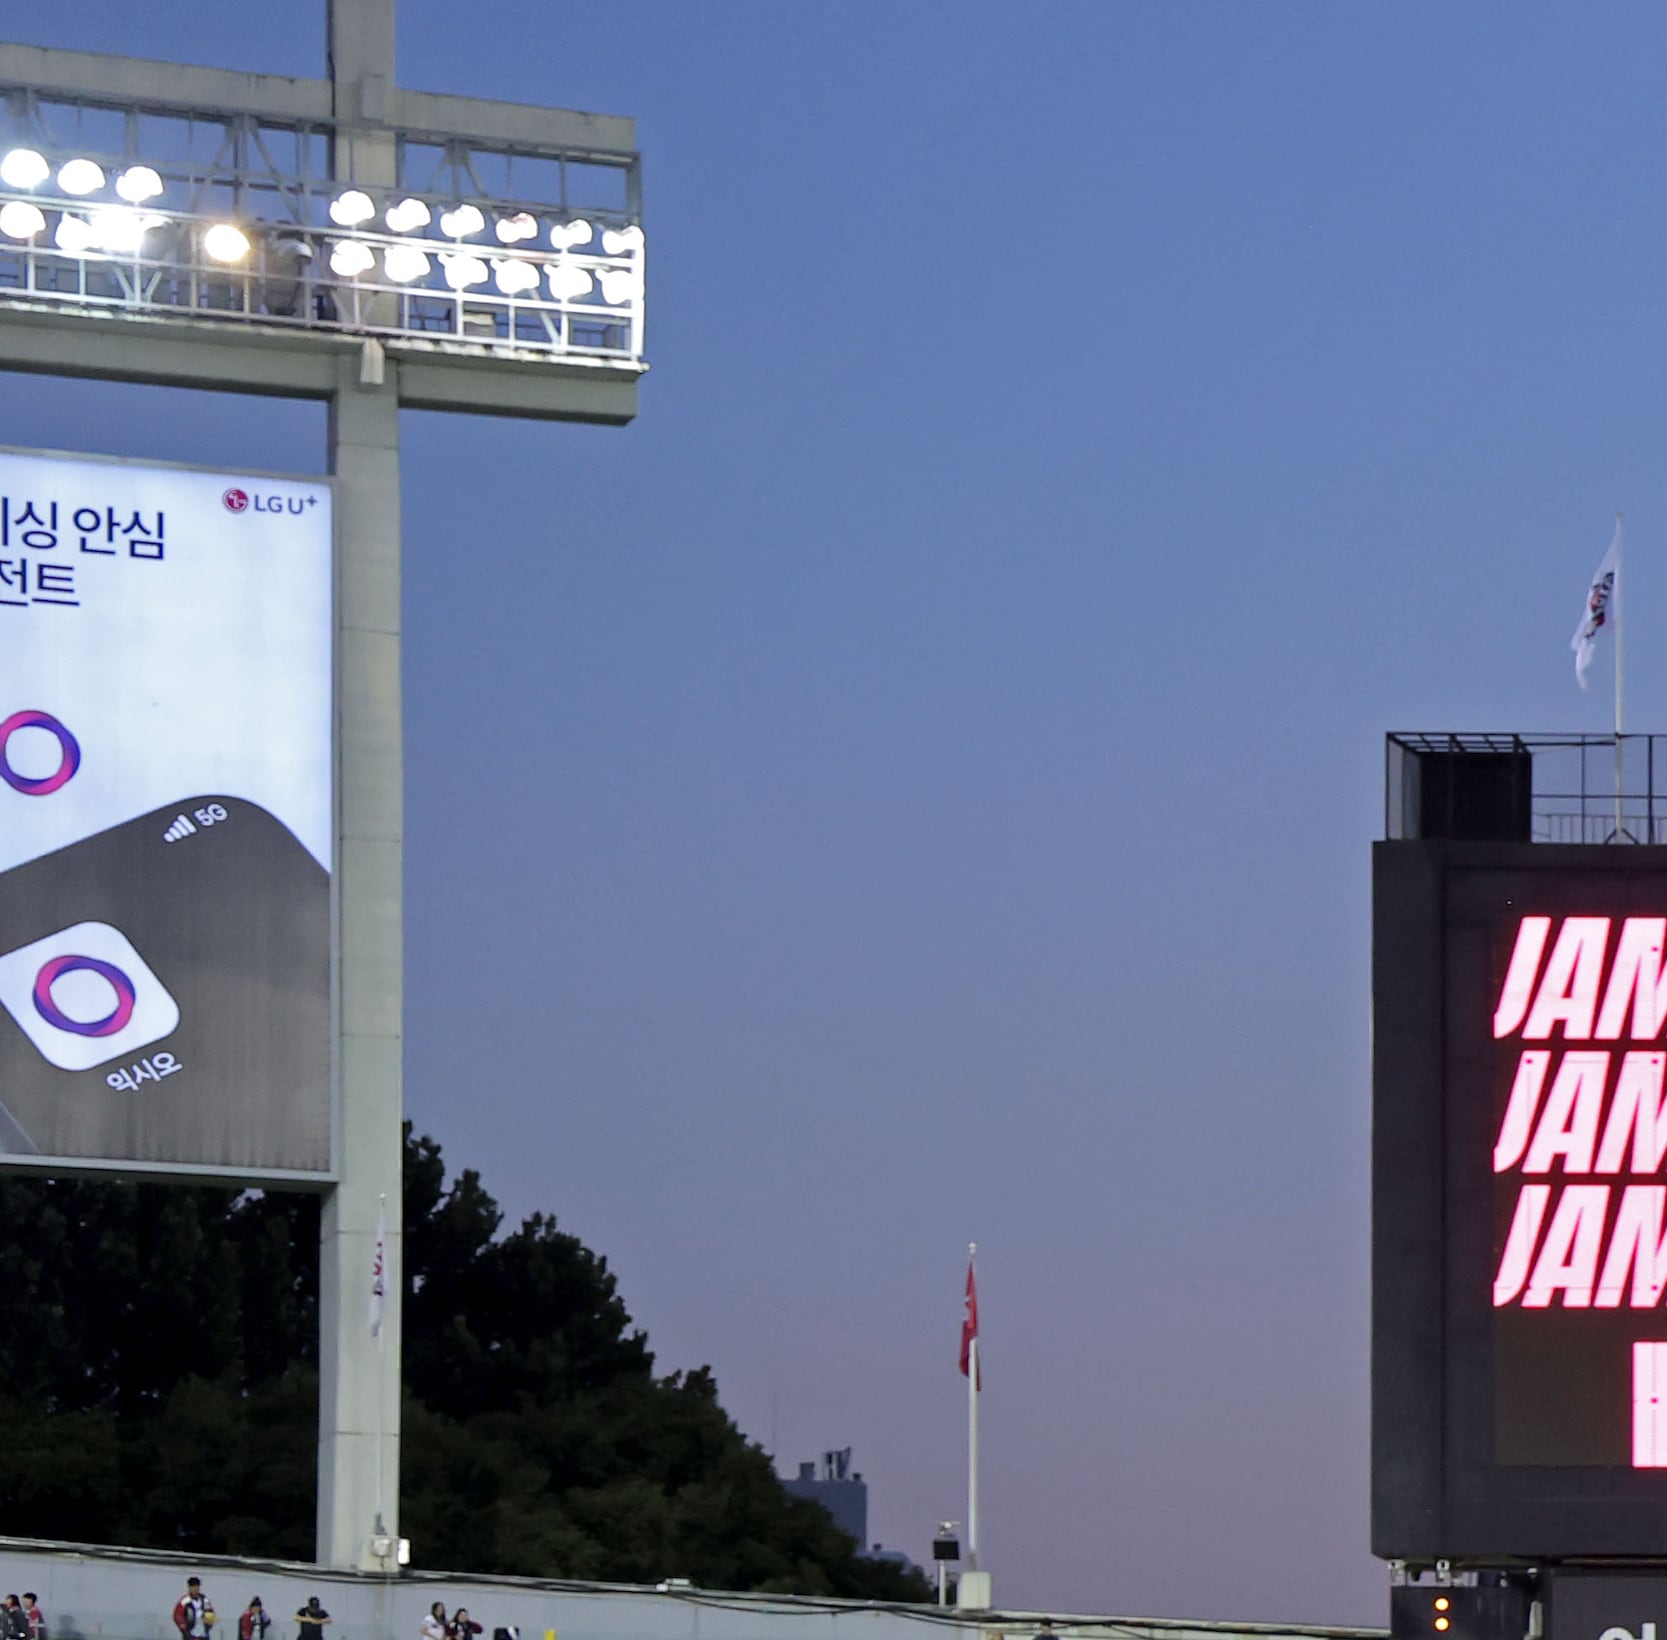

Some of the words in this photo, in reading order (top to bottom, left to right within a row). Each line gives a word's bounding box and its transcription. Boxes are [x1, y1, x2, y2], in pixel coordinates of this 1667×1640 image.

[254, 496, 283, 513] LG
[73, 506, 165, 561] 안심
[194, 803, 229, 828] 5G
